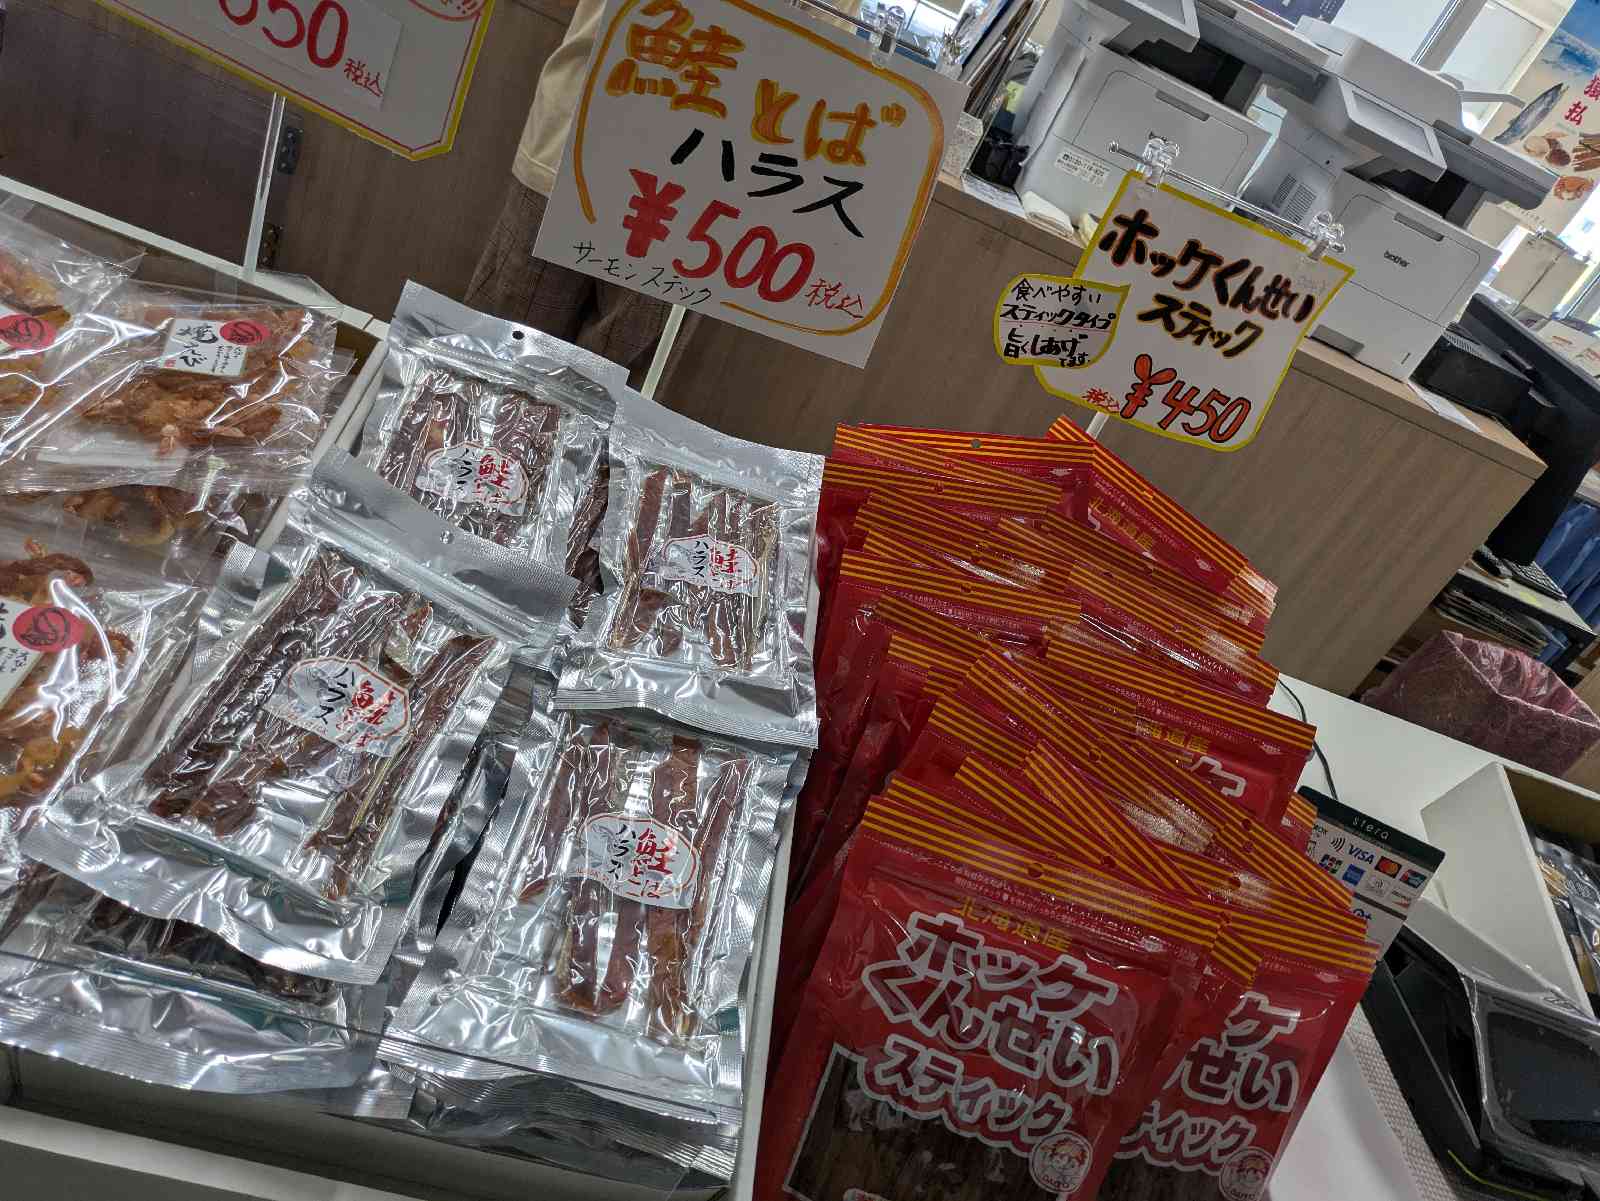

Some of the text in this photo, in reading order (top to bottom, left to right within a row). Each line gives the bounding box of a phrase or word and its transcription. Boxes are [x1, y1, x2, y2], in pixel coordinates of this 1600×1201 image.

[343, 58, 383, 97] 税込
[605, 0, 907, 166] 鮭とば
[669, 128, 864, 238] ハラス
[622, 168, 866, 319] ¥500 税込
[1098, 208, 1316, 324] ホッケくんせい
[1000, 304, 1117, 330] スティックタイプ
[1011, 278, 1102, 306] 食べやすい
[1137, 292, 1265, 358] スティック
[1119, 353, 1253, 444] ¥450
[312, 667, 355, 724] ハラス
[1348, 843, 1376, 865] VISA
[952, 895, 1073, 951] 北海道産
[897, 912, 1118, 1018] ホッケ
[861, 960, 1119, 1095] くんせい
[862, 1033, 1073, 1142] スティック
[1172, 1037, 1300, 1113] せい
[1136, 1100, 1256, 1164] ィック
